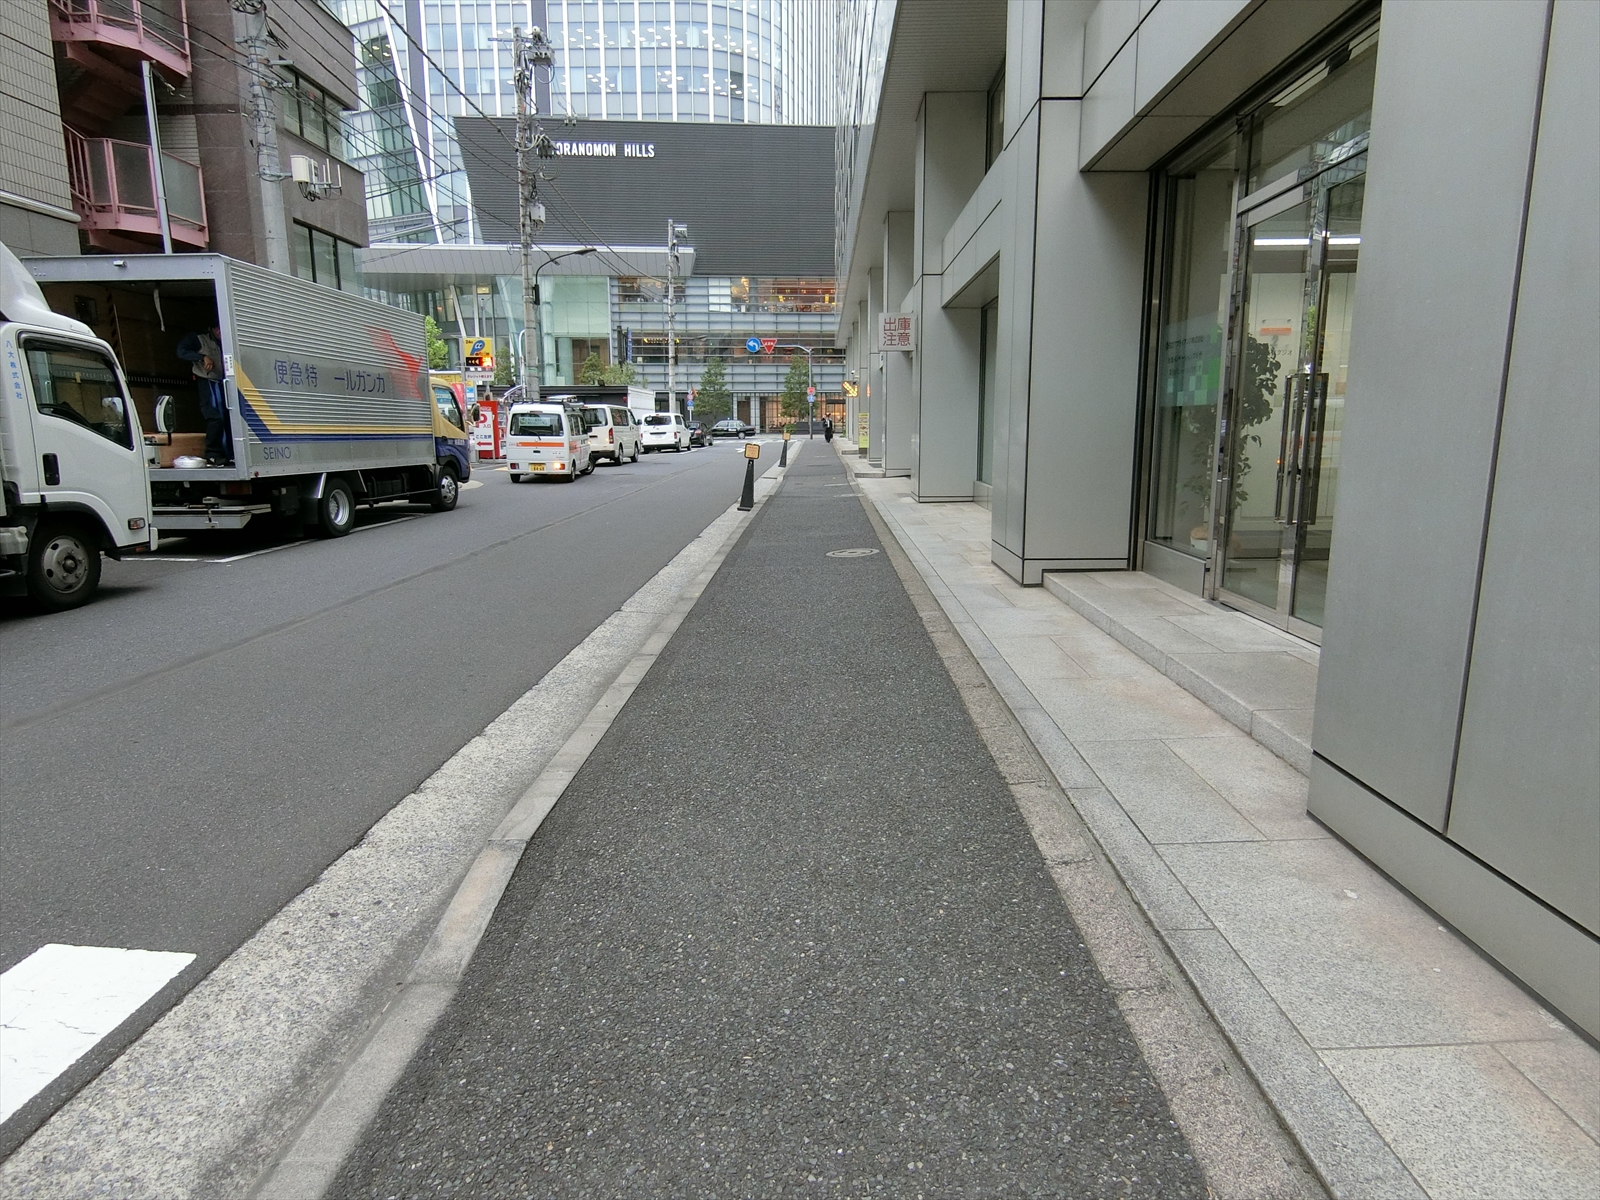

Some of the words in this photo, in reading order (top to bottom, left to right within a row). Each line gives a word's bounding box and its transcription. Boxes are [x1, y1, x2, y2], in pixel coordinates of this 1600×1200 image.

[552, 142, 617, 157] ORANOMON
[624, 144, 655, 157] HILLS
[883, 316, 911, 332] 出庫
[882, 331, 911, 347] 注意
[263, 446, 292, 461] SEINO
